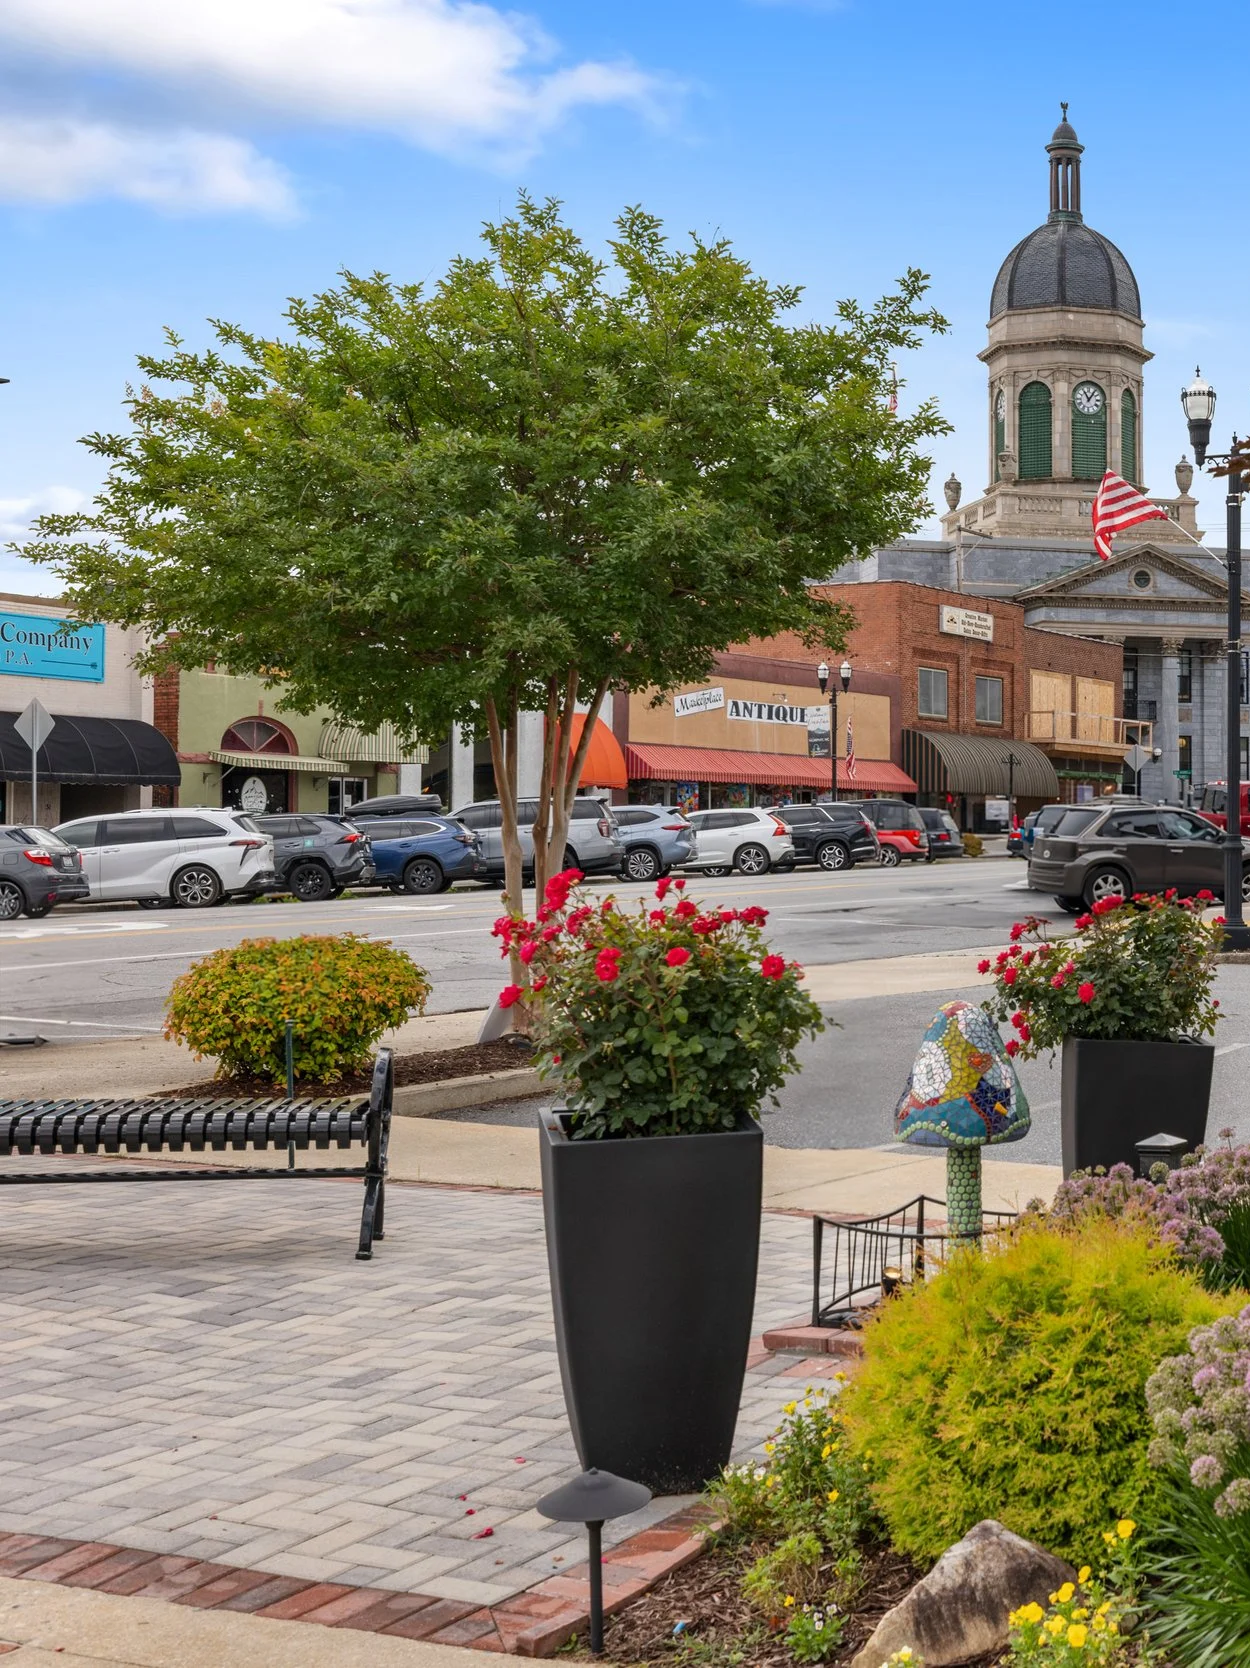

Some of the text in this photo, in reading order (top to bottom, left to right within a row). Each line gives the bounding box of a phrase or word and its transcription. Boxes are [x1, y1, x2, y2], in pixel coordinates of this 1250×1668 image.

[0, 622, 93, 656] Company
[6, 650, 33, 665] P.A.
[676, 691, 722, 712] Marketplace
